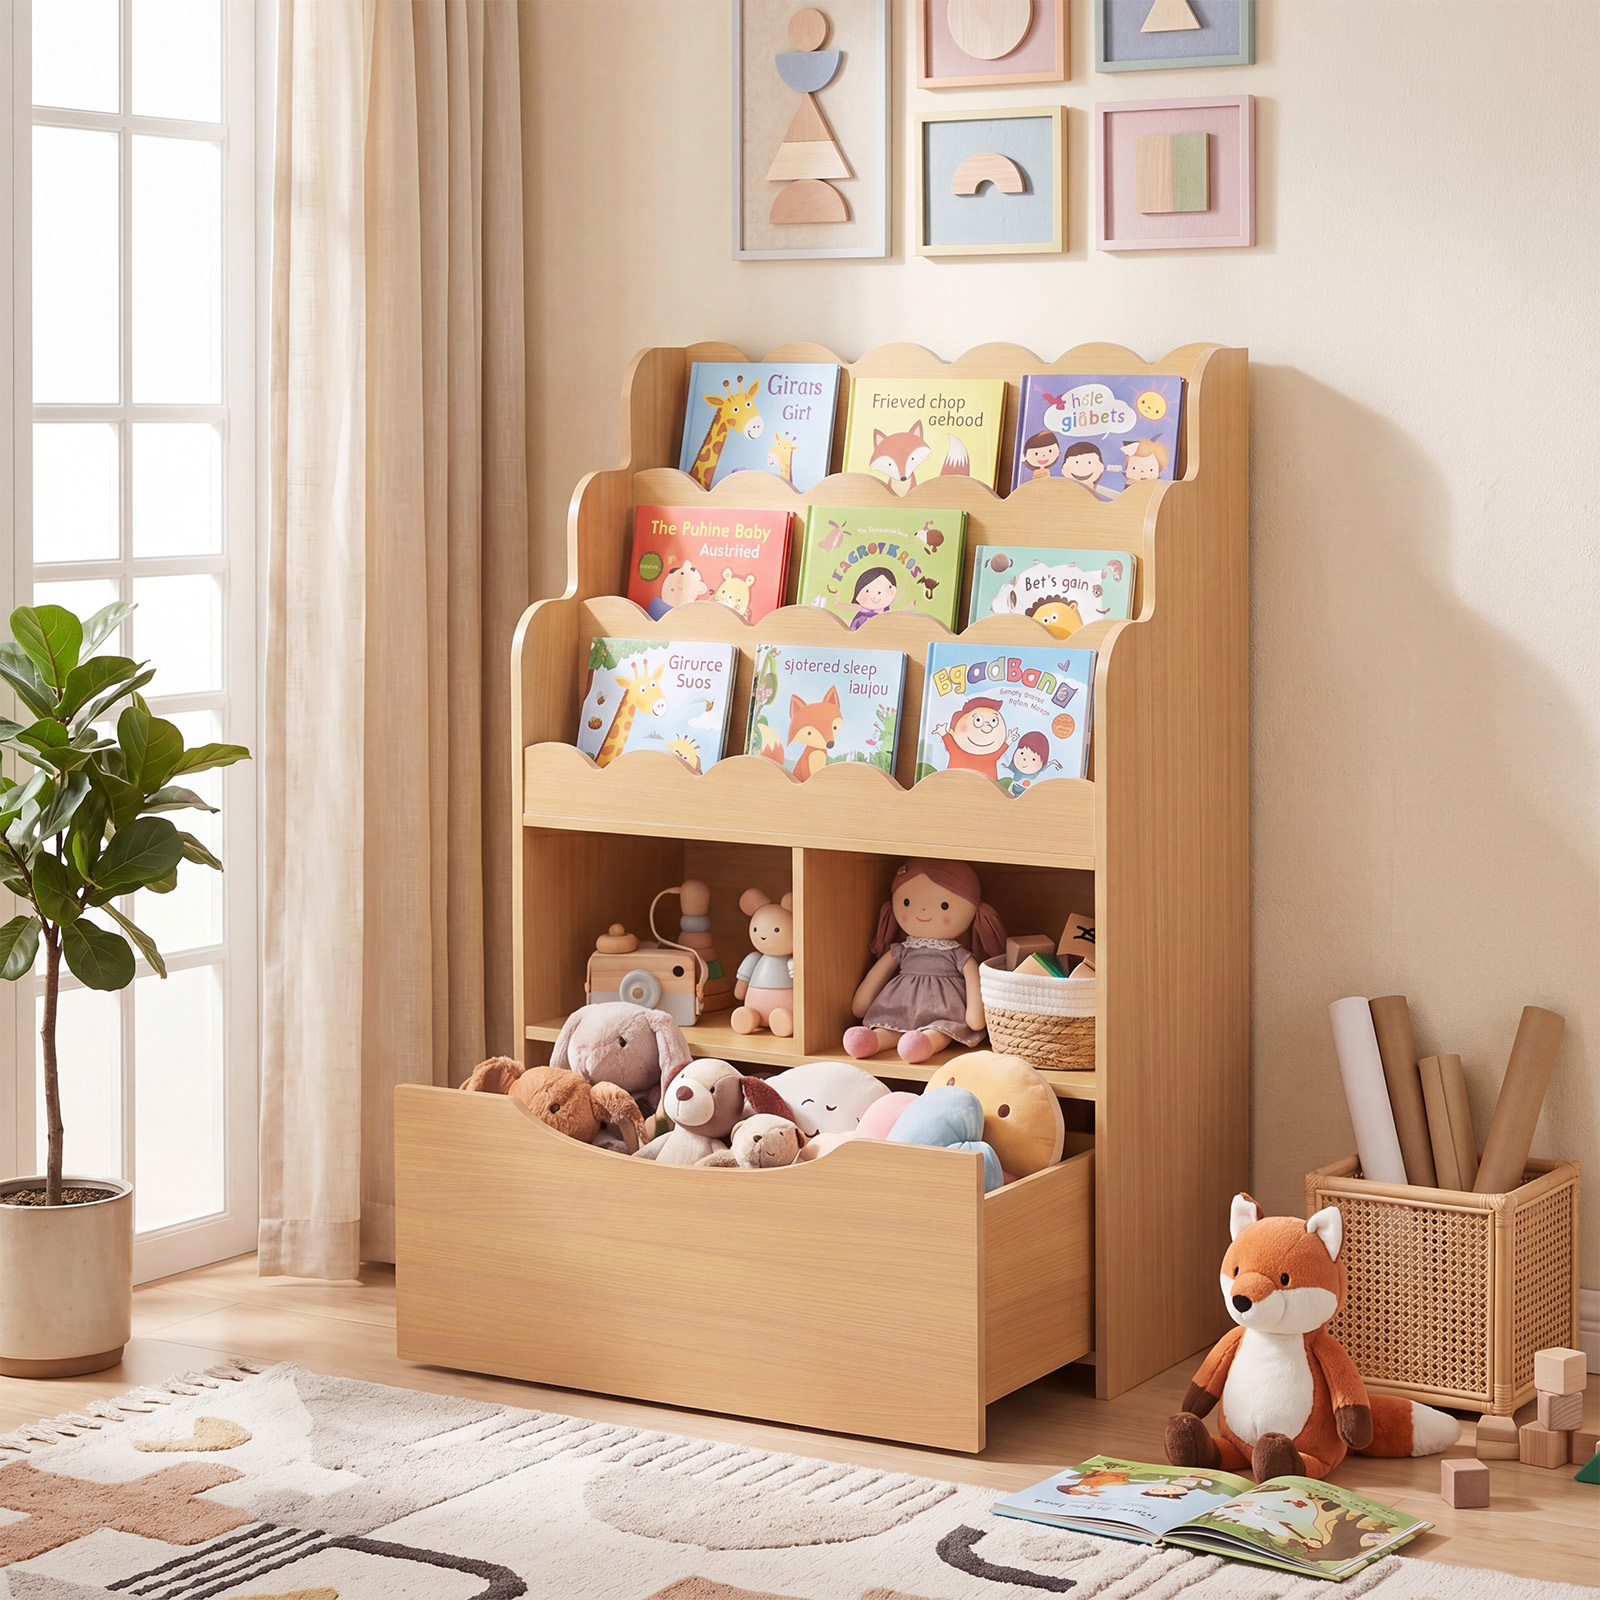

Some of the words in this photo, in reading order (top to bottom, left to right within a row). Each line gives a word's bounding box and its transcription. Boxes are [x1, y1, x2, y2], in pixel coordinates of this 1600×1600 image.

[872, 393, 926, 408] Frieved
[929, 393, 966, 413] chop
[651, 520, 677, 535] The
[682, 521, 730, 538] Puhine
[735, 523, 771, 544] Baby
[1025, 574, 1057, 591] Bet's
[1062, 578, 1089, 593] gain
[669, 655, 723, 672] Girurce
[784, 658, 841, 675] sjotered
[843, 659, 877, 681] sleep
[676, 673, 711, 689] Suos
